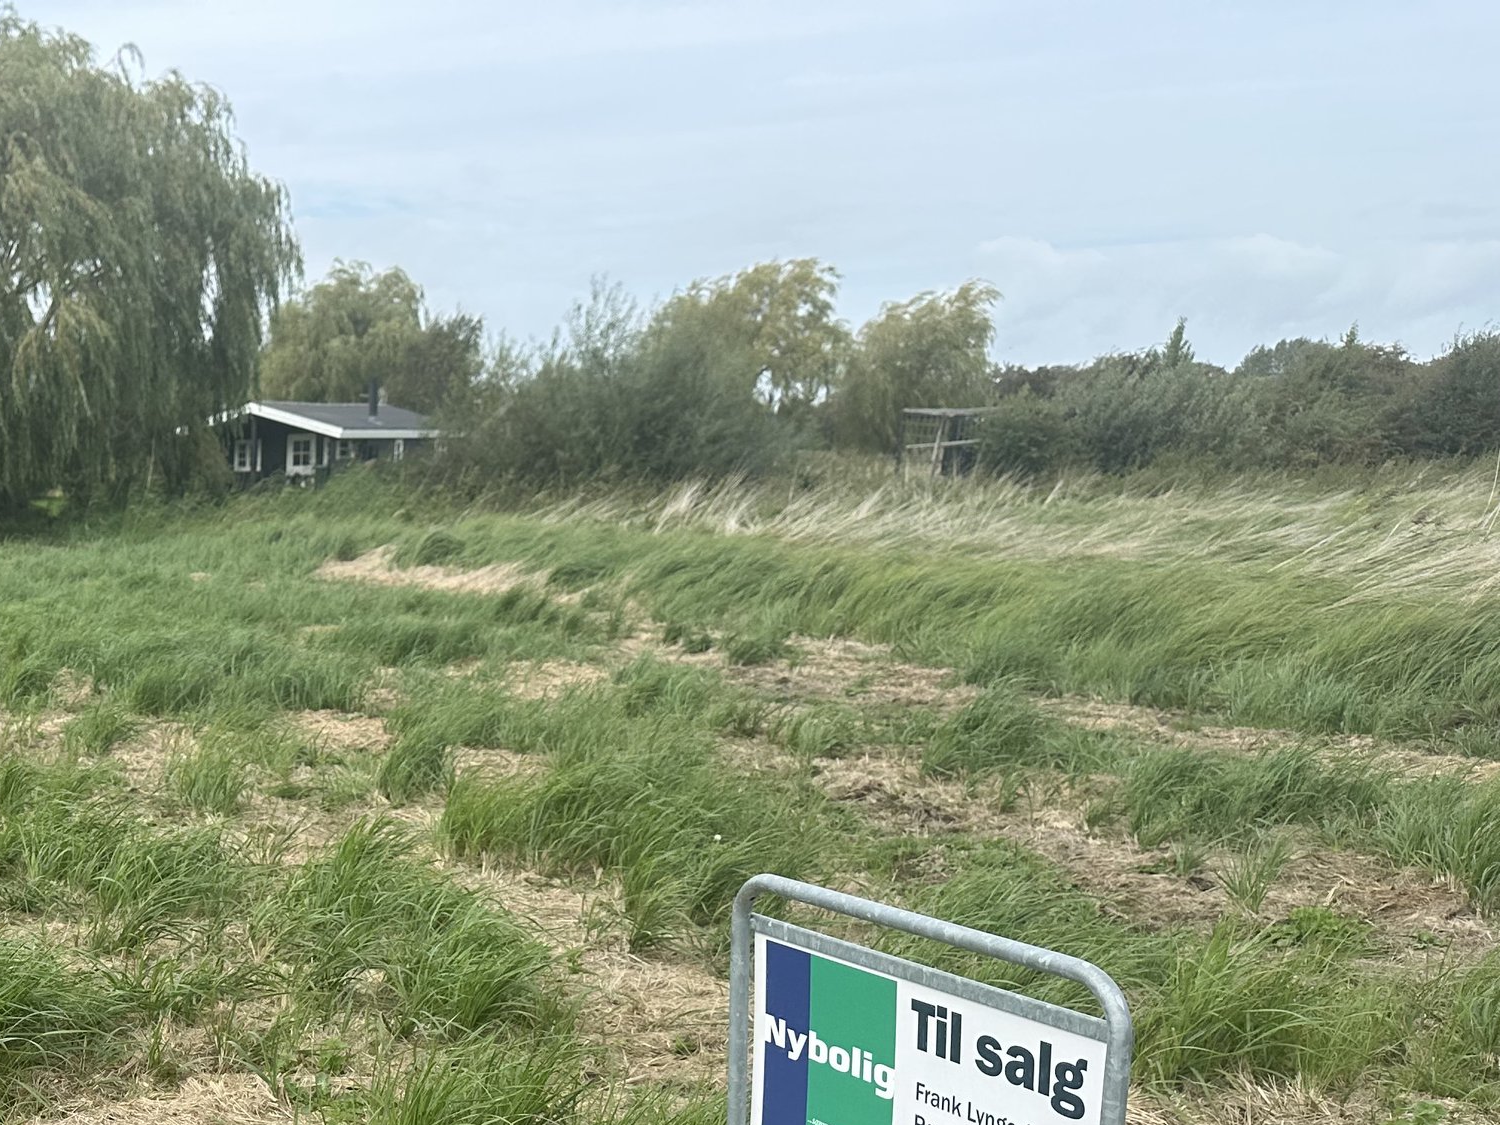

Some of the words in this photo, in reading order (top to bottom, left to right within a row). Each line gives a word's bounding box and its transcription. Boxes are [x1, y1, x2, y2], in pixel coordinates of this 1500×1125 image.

[764, 1013, 895, 1100] Nybolig
[911, 998, 963, 1065] Til
[975, 1033, 1088, 1120] salg
[915, 1082, 962, 1117] Frank
